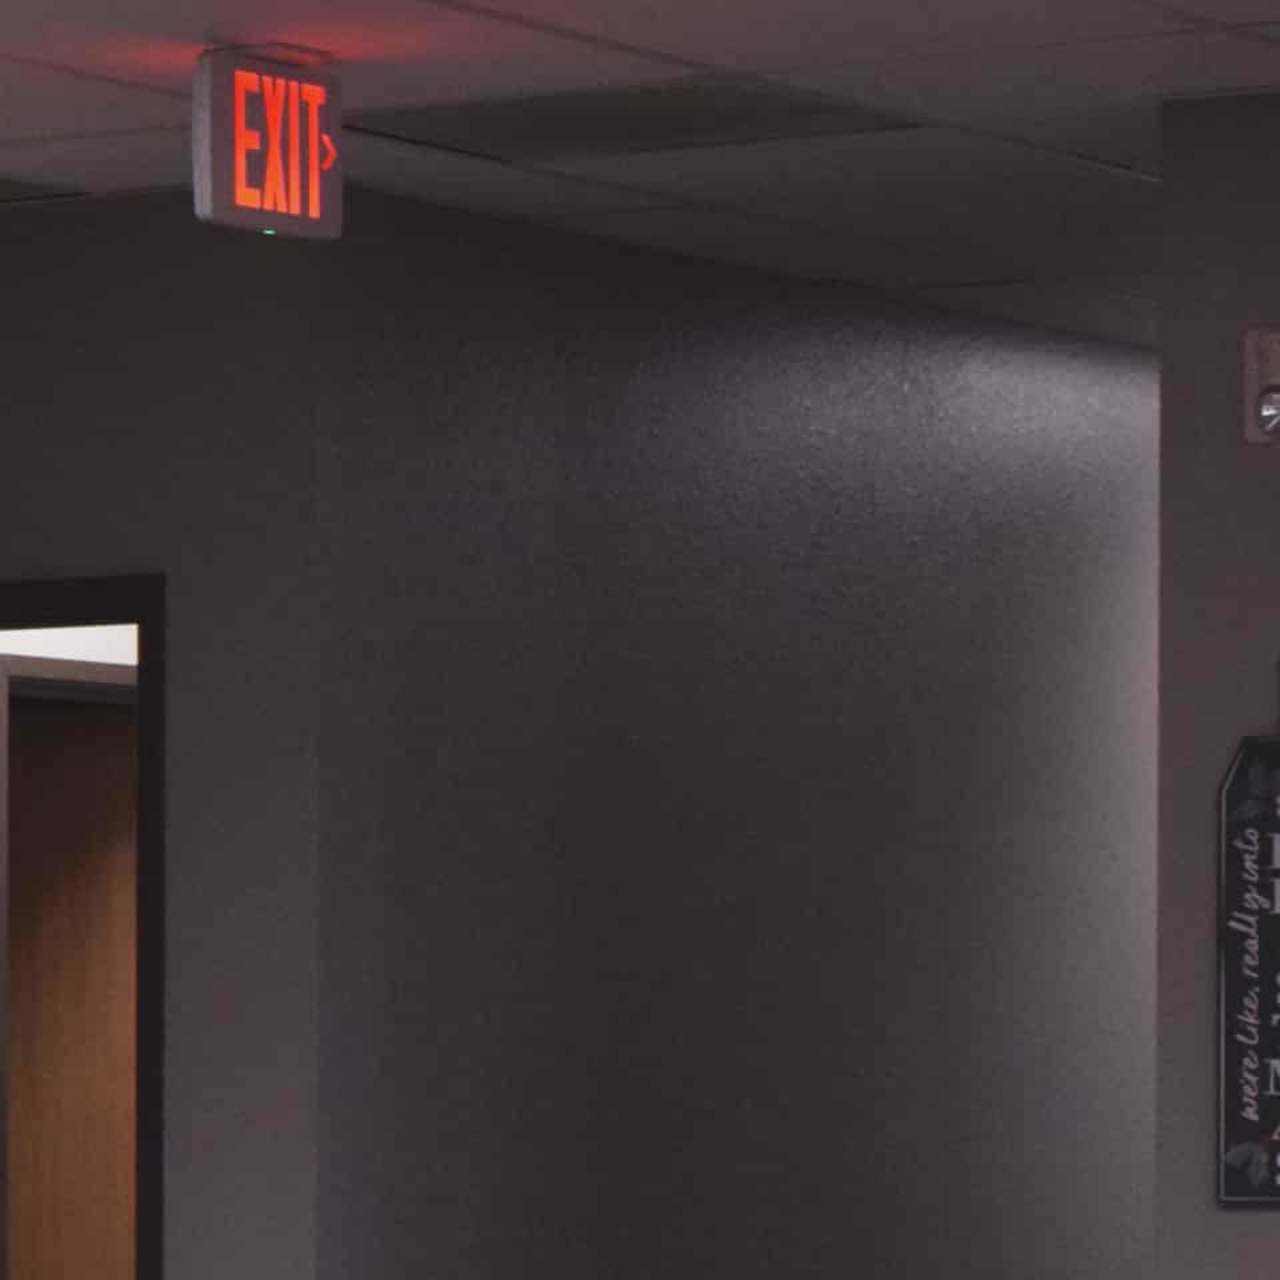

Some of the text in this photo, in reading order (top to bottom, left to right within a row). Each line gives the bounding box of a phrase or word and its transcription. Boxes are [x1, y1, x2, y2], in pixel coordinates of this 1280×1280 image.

[234, 70, 327, 219] EXIT
[1233, 828, 1260, 884] into
[1227, 884, 1271, 976] really
